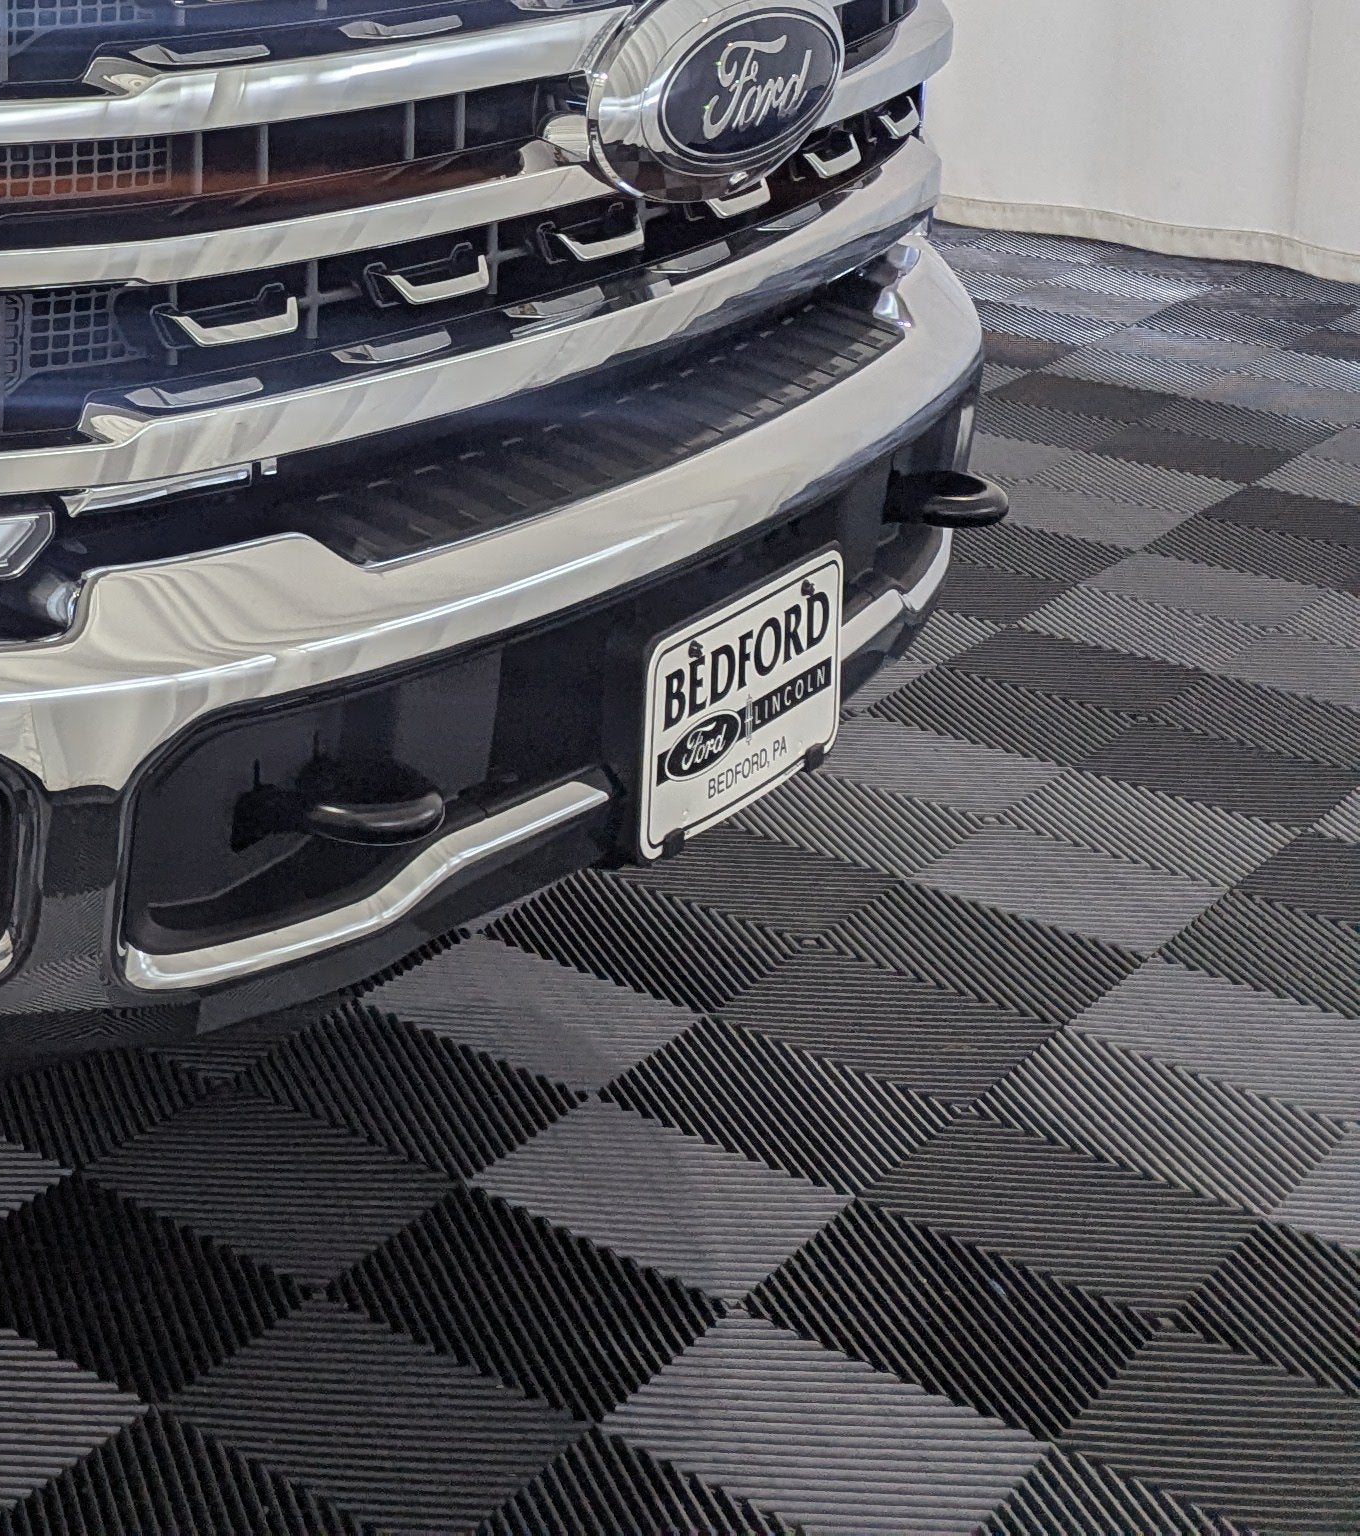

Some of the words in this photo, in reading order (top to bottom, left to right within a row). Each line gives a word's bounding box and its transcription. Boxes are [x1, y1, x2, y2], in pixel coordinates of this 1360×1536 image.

[703, 36, 812, 140] Ford
[663, 591, 830, 731] BEDFORD
[682, 724, 726, 770] Ford
[753, 666, 826, 725] LINCOLN
[708, 748, 771, 799] BEDFORD,
[773, 736, 788, 759] PA
